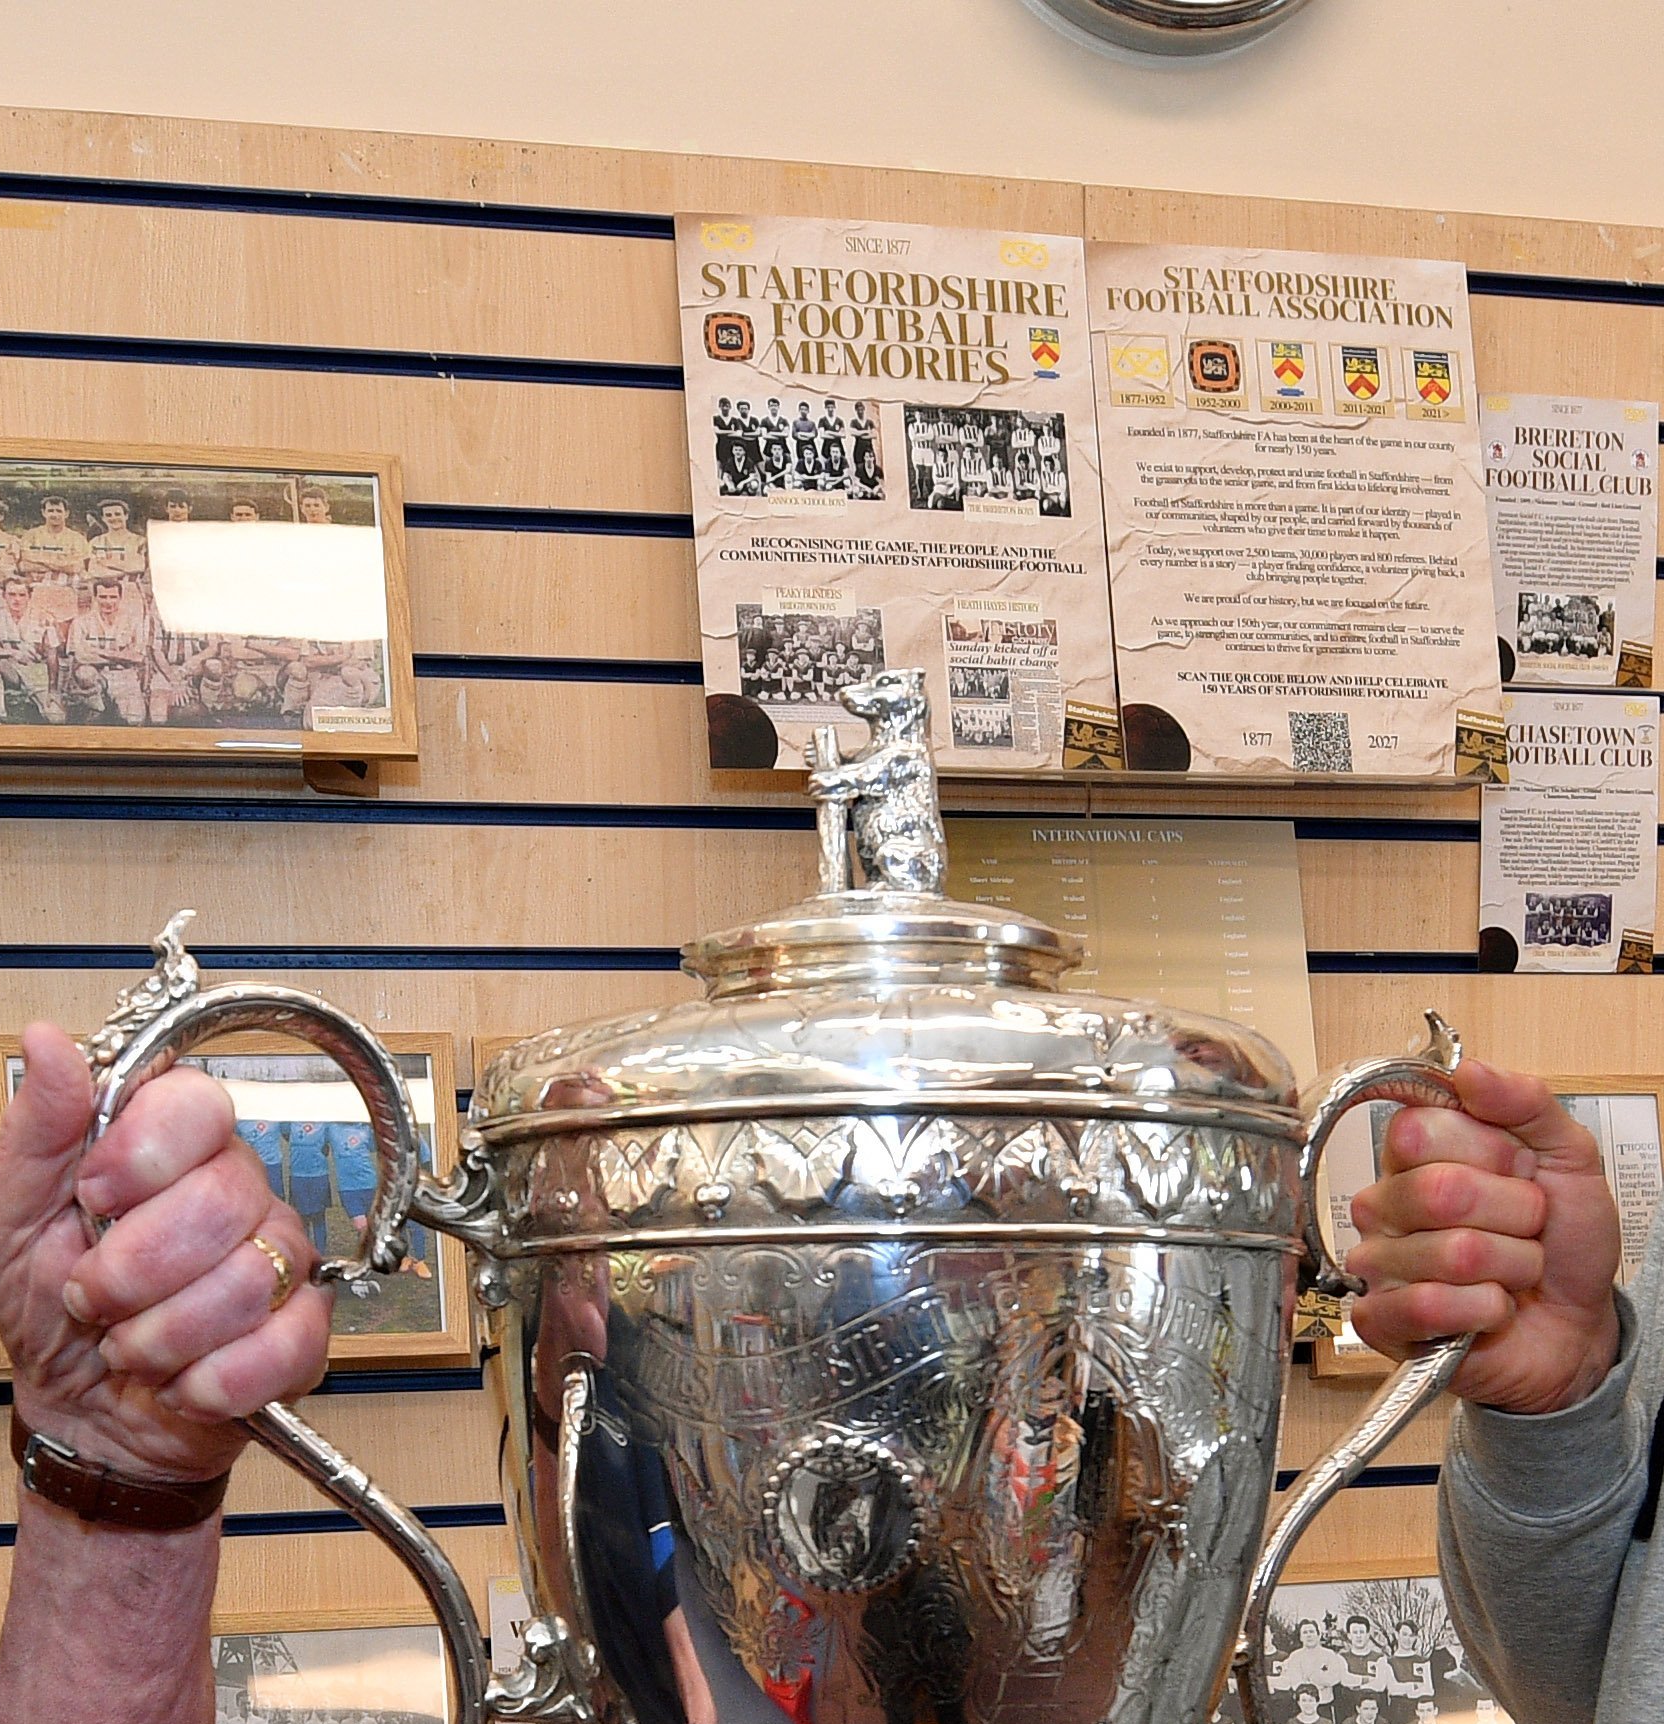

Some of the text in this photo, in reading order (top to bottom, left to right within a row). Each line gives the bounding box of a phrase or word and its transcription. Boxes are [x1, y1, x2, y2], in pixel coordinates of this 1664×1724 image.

[845, 237, 911, 256] SINCE 1877
[701, 263, 1069, 318] STAFFORDSHIRE
[1164, 266, 1397, 301] STAFFORDSHIRE
[1106, 287, 1453, 330] FOOTBALL ASSOCIATION
[773, 303, 1008, 349] FOOTBALL
[775, 340, 1010, 385] MEMORIES
[1120, 394, 1442, 419] 1877-1952 1952-2000 2000-2011 2011-2021 2021
[1514, 427, 1624, 451] BRERETON
[1532, 450, 1606, 472] SOCIAL
[1485, 468, 1653, 496] FOOTBALL CLUB
[968, 503, 1034, 516] THE BRERETON BOYS
[751, 536, 1056, 560] RECOGNISING THE GAME, THE PEOPLE AND THE
[719, 550, 1087, 574] COMMUNITIES THAT SHAPED STAFFORDSHIRE FOOTBALL
[776, 587, 842, 601] PEAKY BLINDERS
[957, 600, 1039, 613] HEATH HAYES HISTORY
[948, 641, 990, 656] Sunday
[993, 644, 1030, 655] kicked
[1033, 644, 1048, 658] off
[950, 655, 1059, 670] social habit change
[1177, 671, 1448, 689] SCAN THE QR CODE BELOW AND HELP CELEBRATE
[1202, 685, 1428, 700] 150 YEARS OF STAFFORDSHIRE FOOTBALL!
[1067, 704, 1118, 721] Staffordshire
[1458, 713, 1505, 730] Staffordshire
[1241, 733, 1398, 750] 1877 2027
[1506, 724, 1636, 746] CHASETOWN
[1508, 745, 1653, 768] OTBALL CLUB
[1032, 829, 1183, 844] INTERNATIONAL CAPS
